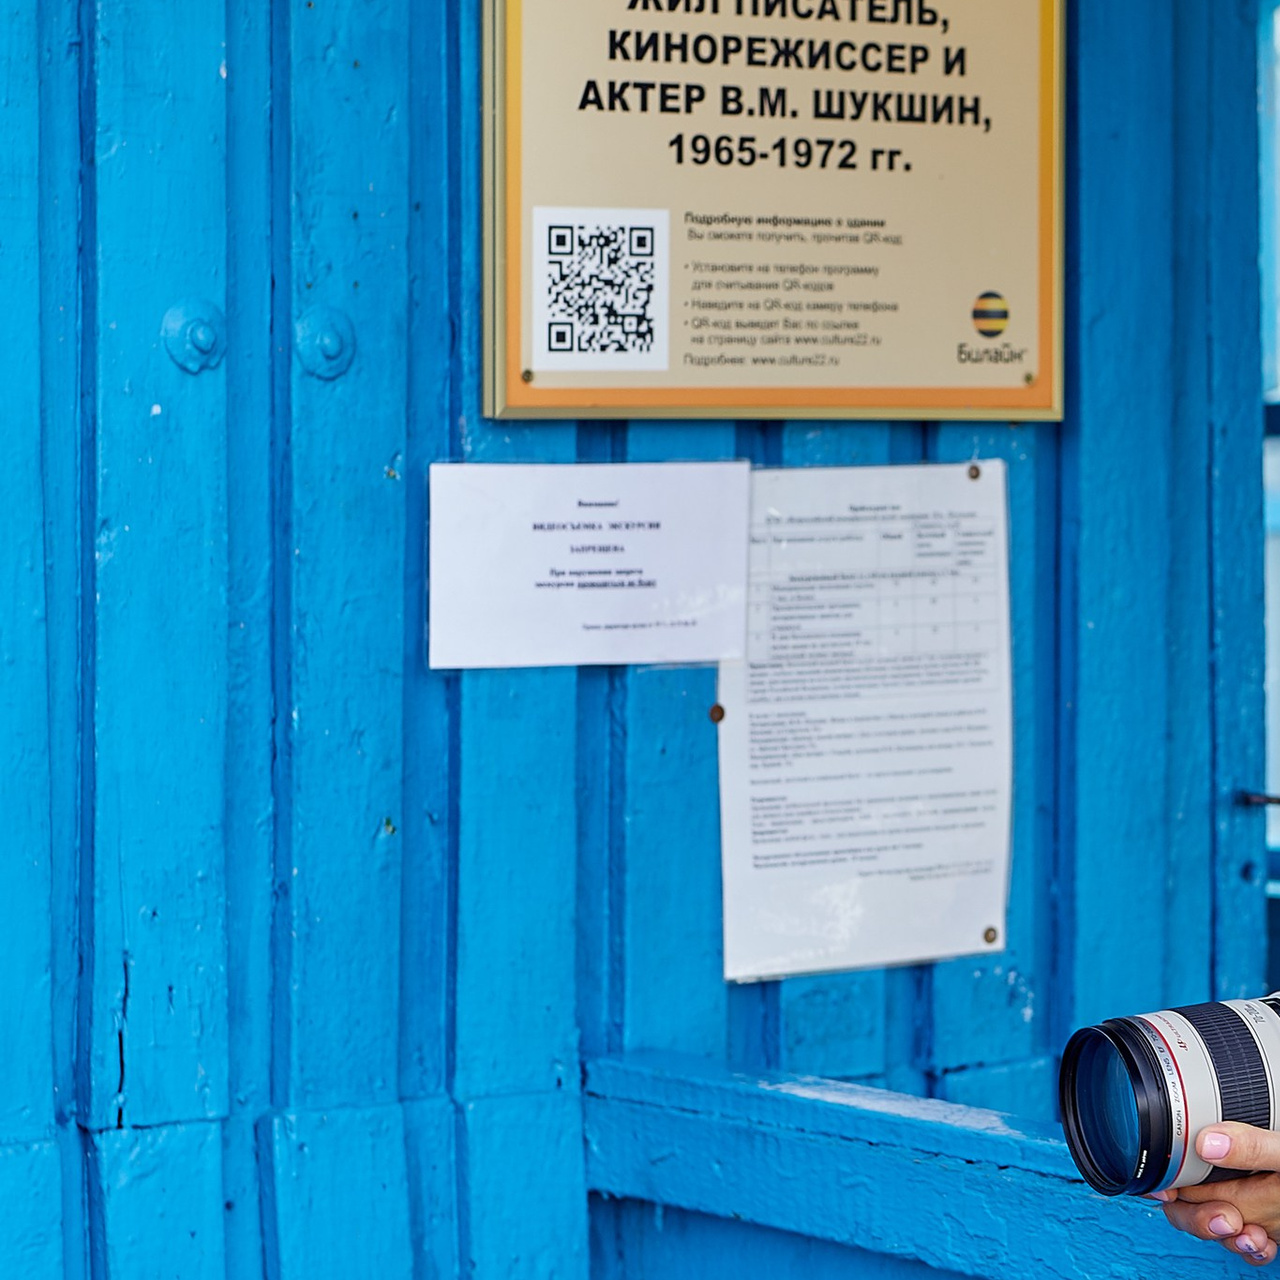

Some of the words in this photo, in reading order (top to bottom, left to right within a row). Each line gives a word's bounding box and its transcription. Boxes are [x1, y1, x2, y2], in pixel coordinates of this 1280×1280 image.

[608, 29, 930, 75] КИНОРЕЖИССЕР
[943, 46, 966, 77] И
[578, 80, 706, 114] АКТЕР
[721, 85, 798, 119] В.М.
[813, 89, 991, 133] ШУКШИН,
[669, 133, 857, 170] 1965-1972
[871, 149, 912, 172] гг.
